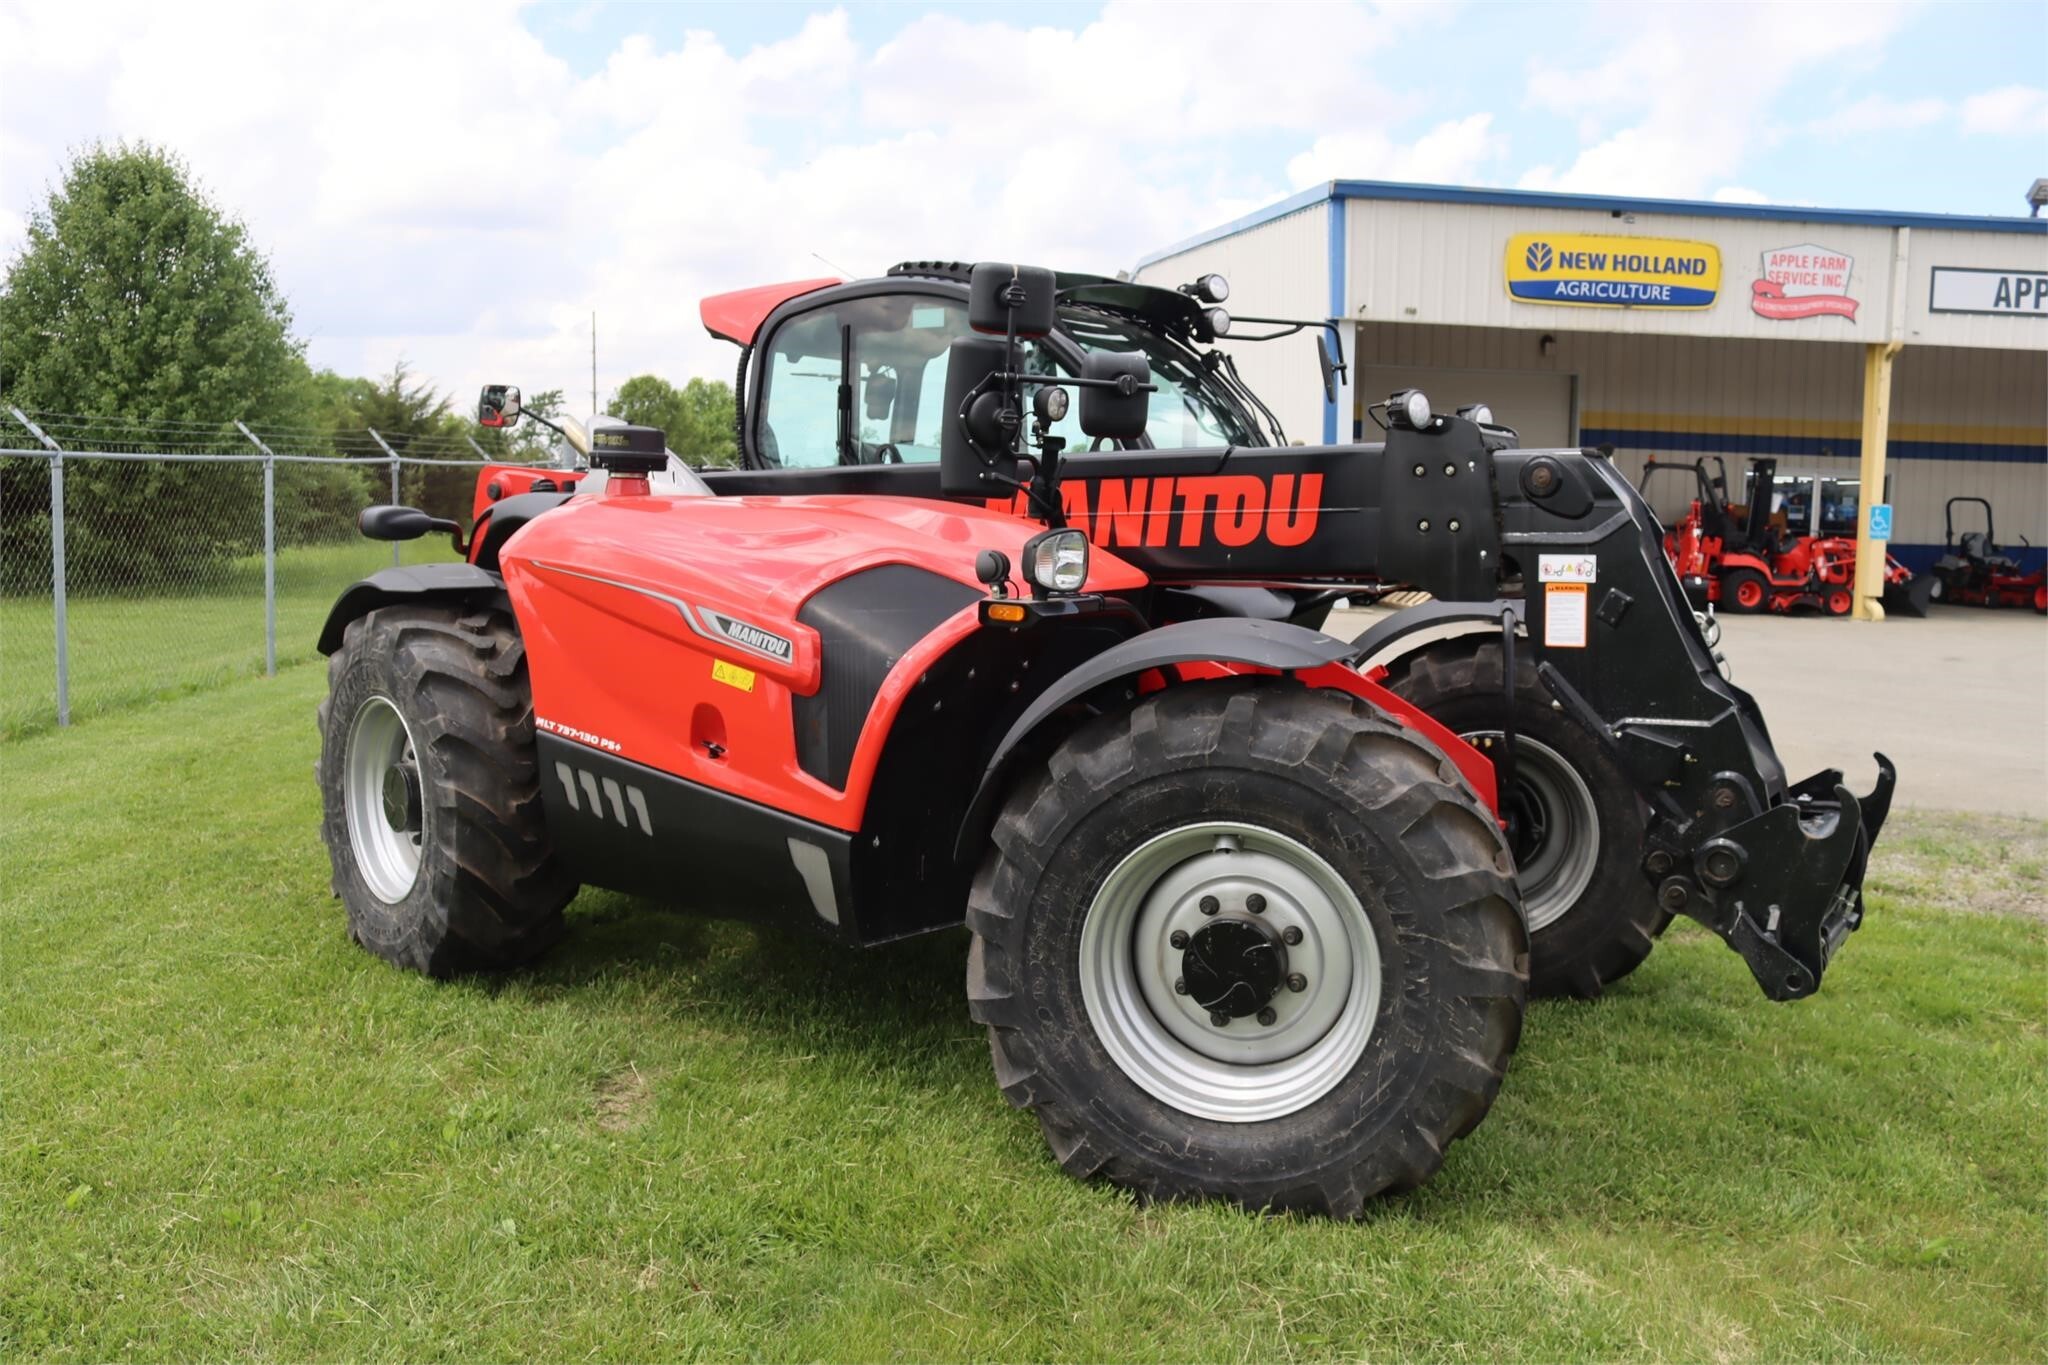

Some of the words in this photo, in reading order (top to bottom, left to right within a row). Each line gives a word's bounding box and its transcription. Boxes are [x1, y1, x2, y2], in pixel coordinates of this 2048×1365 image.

[1559, 251, 1607, 270] NEW
[1612, 254, 1707, 276] HOLLAND
[1770, 253, 1810, 269] APPLE
[1813, 256, 1847, 271] FARM
[1768, 270, 1818, 286] SERVICE
[1554, 281, 1671, 301] AGRICULTURE
[727, 621, 788, 656] MANITOU
[535, 716, 557, 730] MLT
[557, 723, 600, 745] 737-130
[600, 737, 622, 752] PS+
